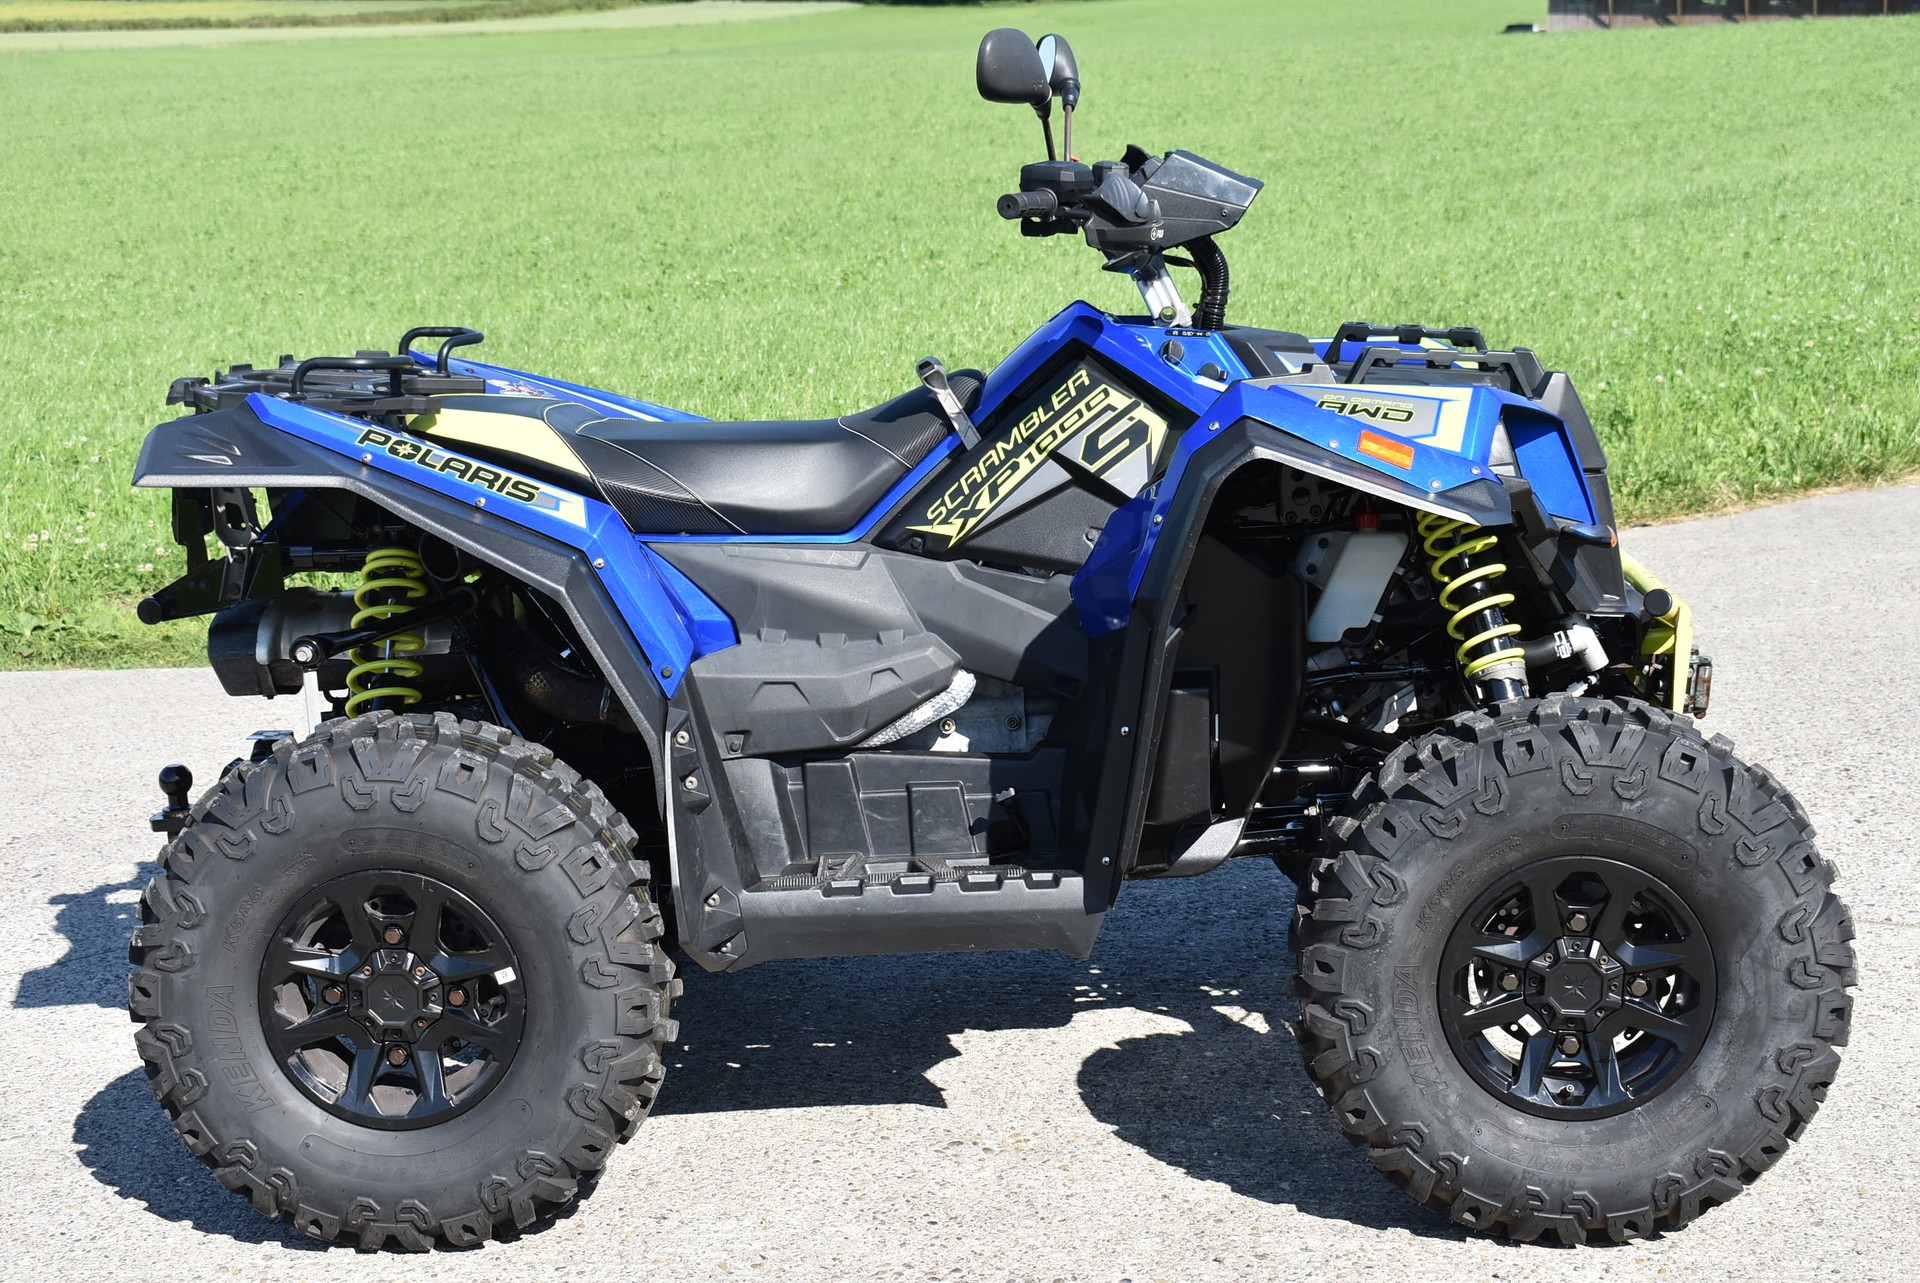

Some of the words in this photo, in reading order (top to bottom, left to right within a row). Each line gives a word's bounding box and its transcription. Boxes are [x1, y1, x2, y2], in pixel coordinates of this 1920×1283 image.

[926, 367, 1091, 531] SCRAMBLER
[1077, 396, 1153, 480] S
[1315, 399, 1416, 424] AWD
[355, 426, 541, 505] POLARIS
[205, 983, 276, 1114] KENDA
[1393, 963, 1449, 1097] KENDA
